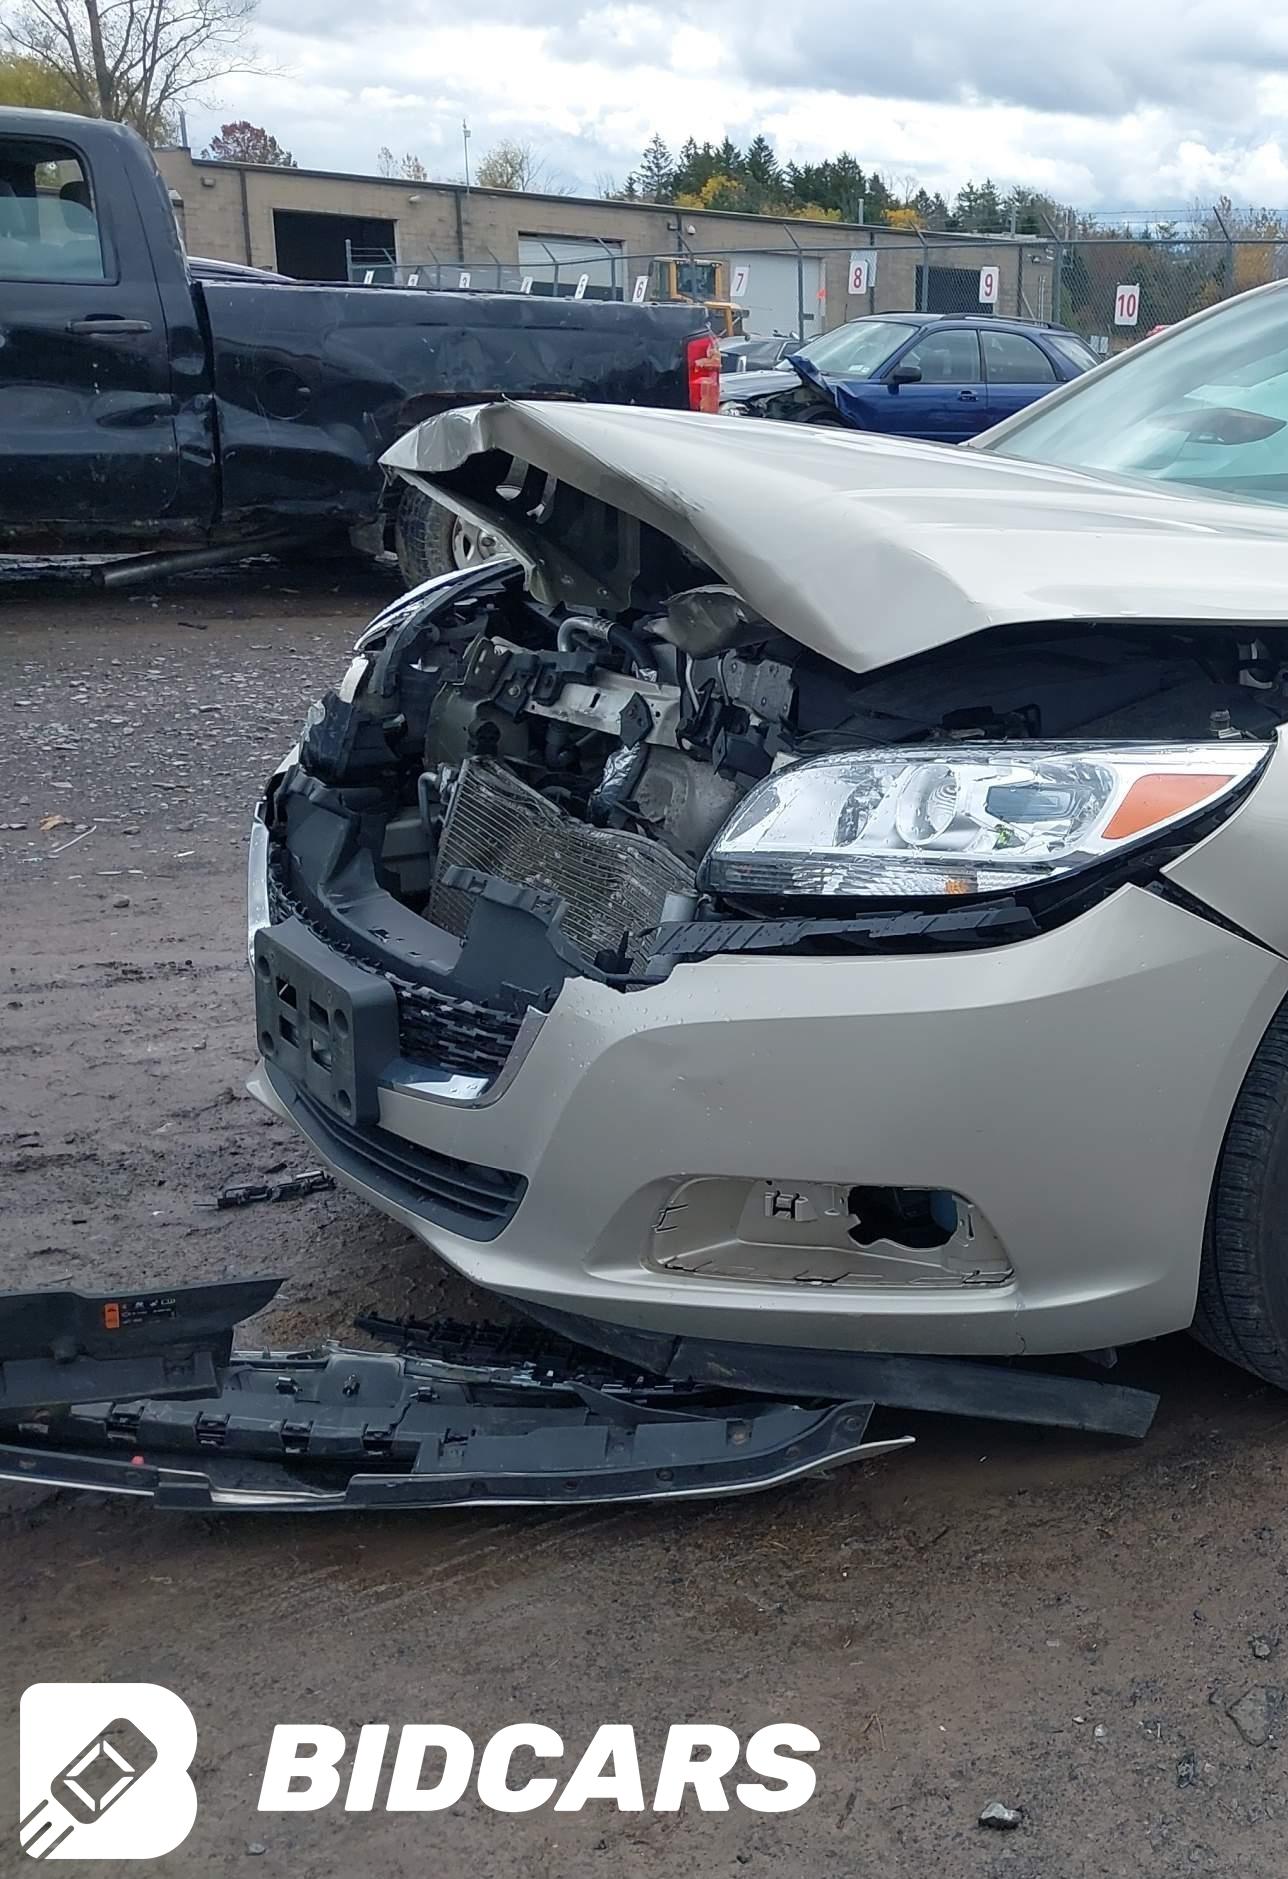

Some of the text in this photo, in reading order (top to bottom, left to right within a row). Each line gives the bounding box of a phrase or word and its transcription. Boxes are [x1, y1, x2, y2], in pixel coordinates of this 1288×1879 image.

[636, 280, 644, 298] 6
[736, 273, 744, 292] 7
[853, 267, 862, 289] 8
[984, 273, 993, 297] 9
[1117, 294, 1136, 318] 10
